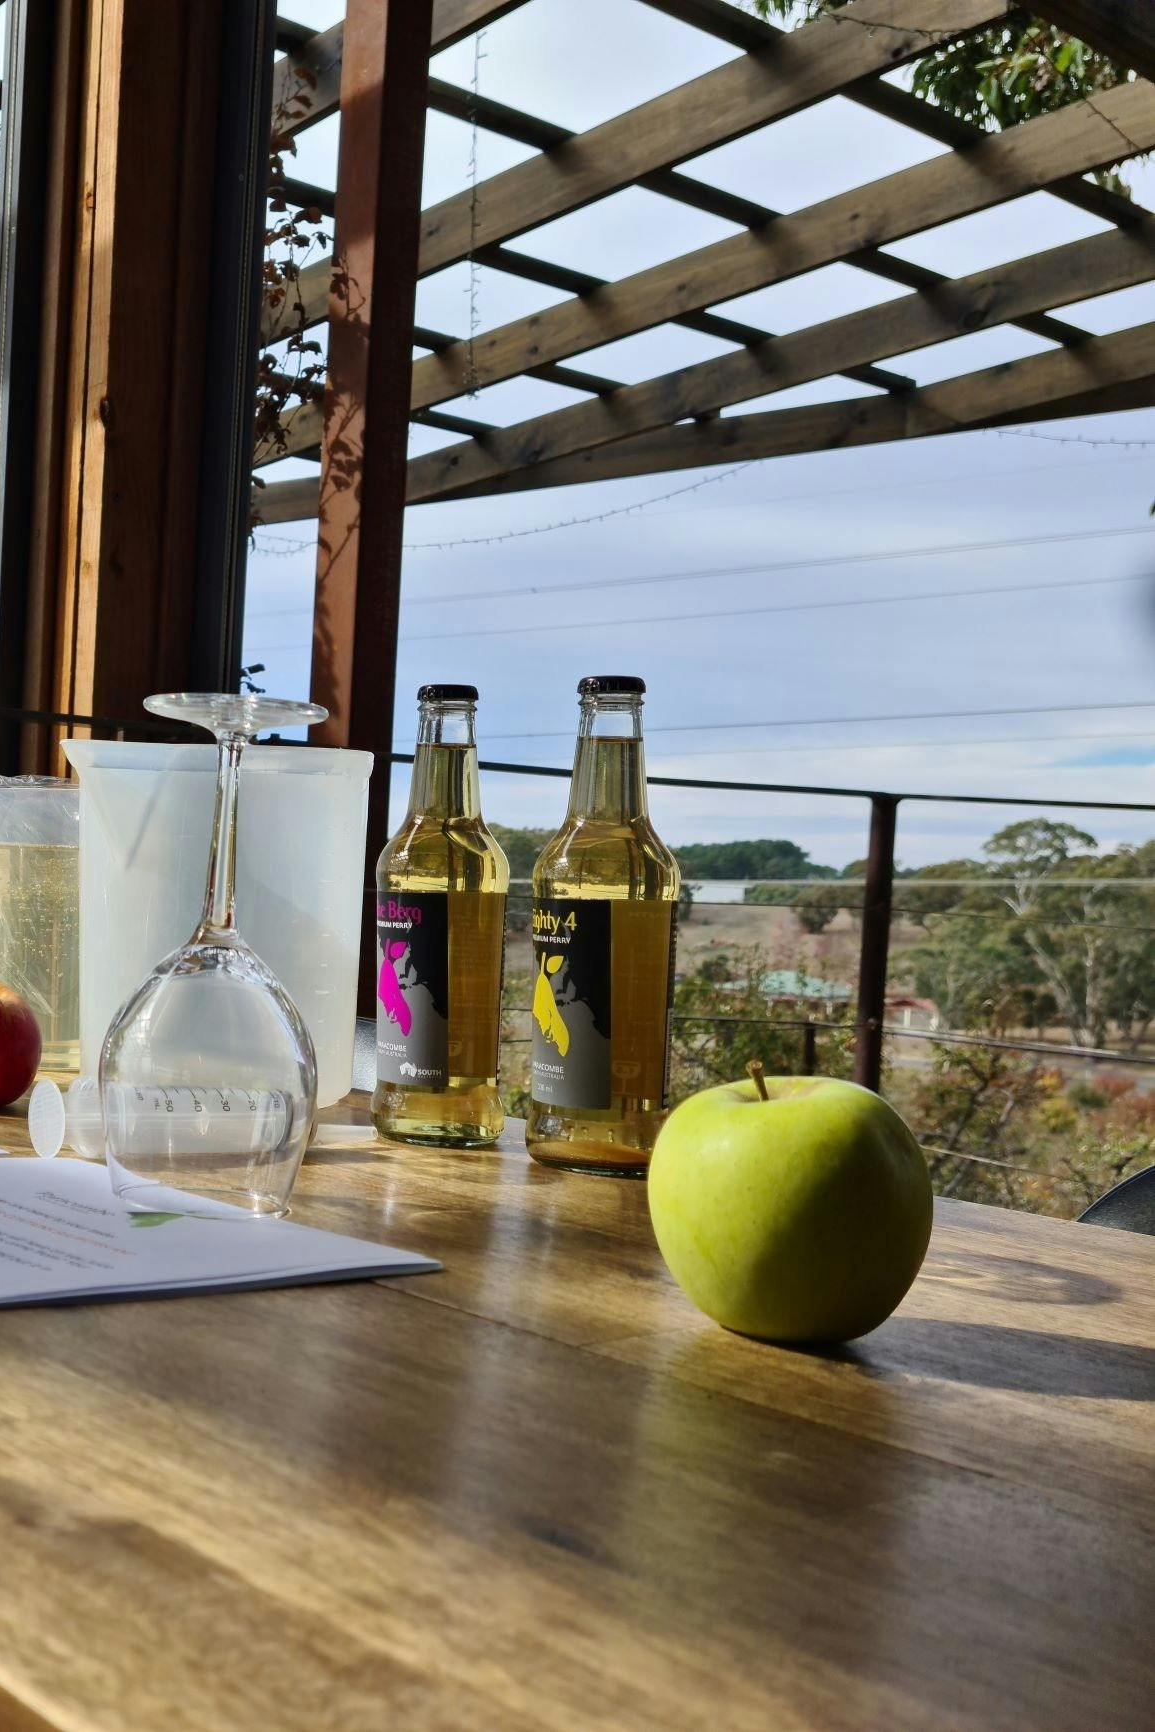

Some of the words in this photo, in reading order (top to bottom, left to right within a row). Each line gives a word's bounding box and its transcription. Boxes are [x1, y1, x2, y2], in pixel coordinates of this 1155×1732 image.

[392, 921, 413, 929] PERRY
[565, 911, 577, 931] 4
[549, 936, 571, 944] PERRY
[417, 1068, 442, 1077] SOUTH
[165, 1100, 174, 1112] 50
[193, 1100, 203, 1112] 40
[221, 1100, 231, 1112] 30
[248, 1100, 257, 1111] 20
